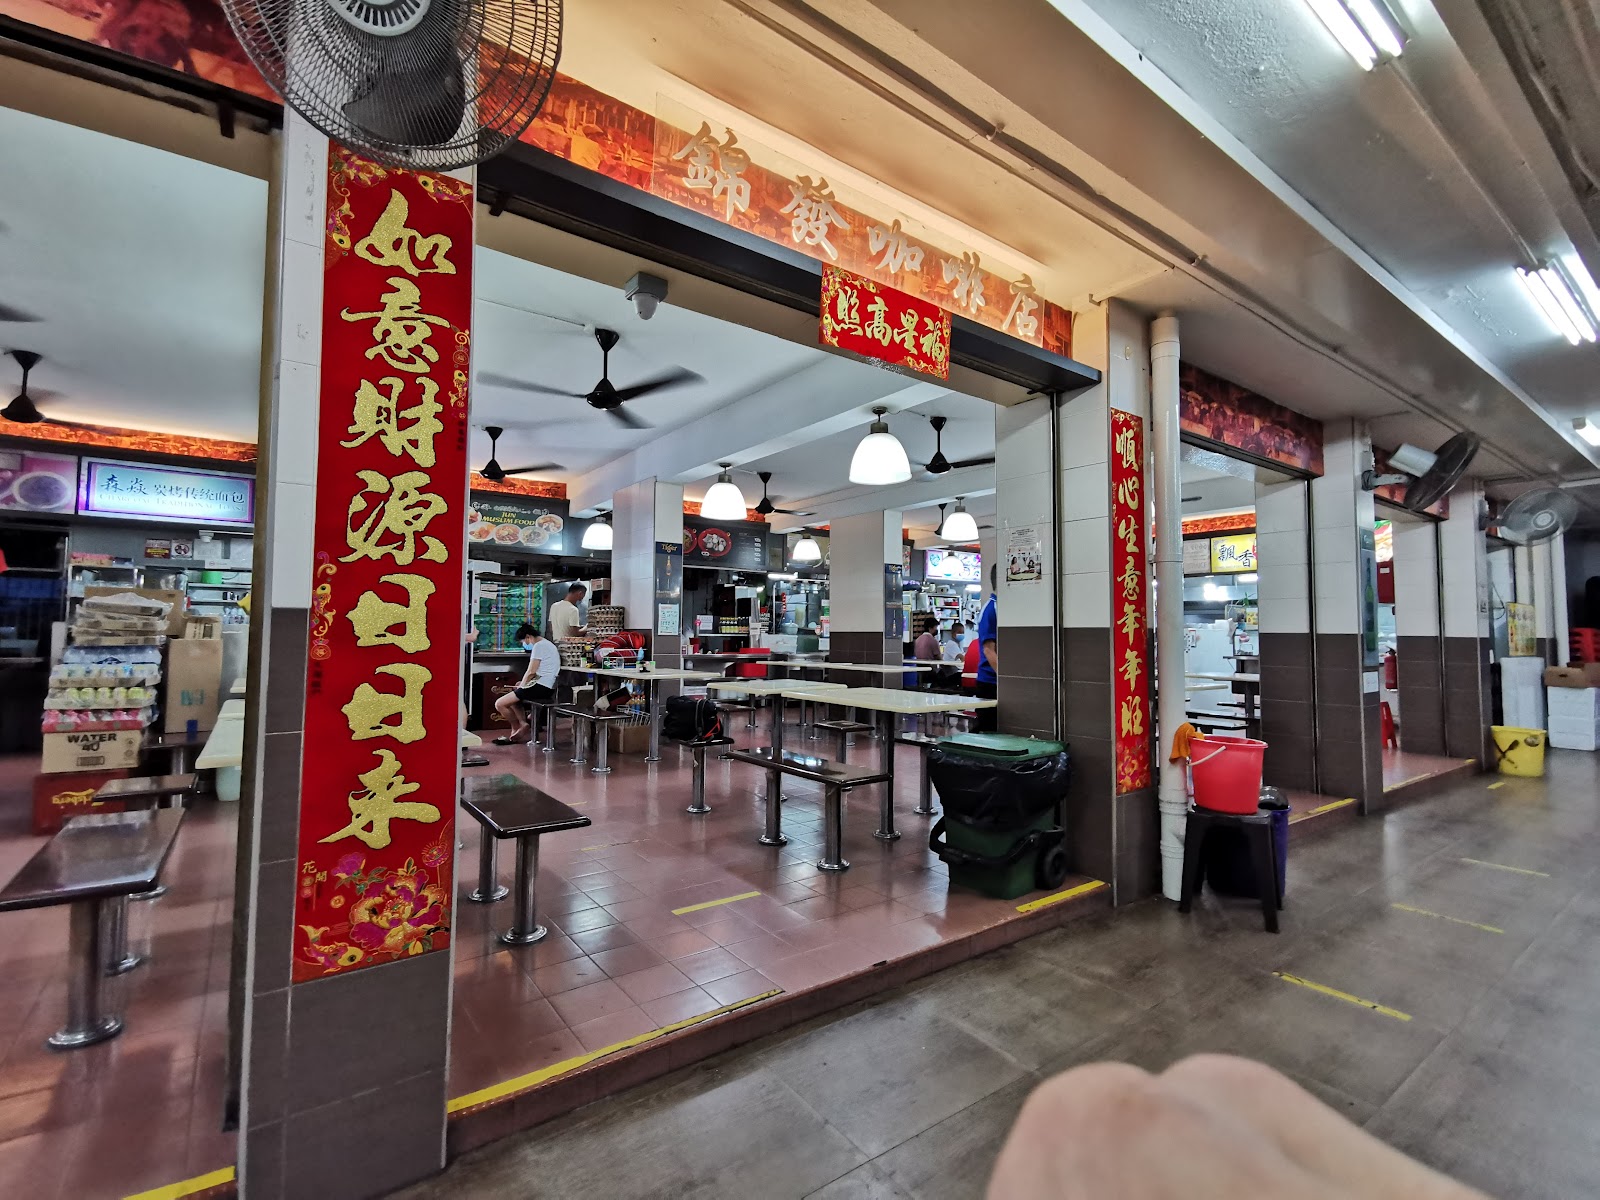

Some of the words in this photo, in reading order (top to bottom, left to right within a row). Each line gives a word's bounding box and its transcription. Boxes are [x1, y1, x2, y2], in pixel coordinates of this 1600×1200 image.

[482, 516, 513, 524] MUSLIM
[661, 543, 678, 553] Tiger
[67, 733, 117, 744] WATER
